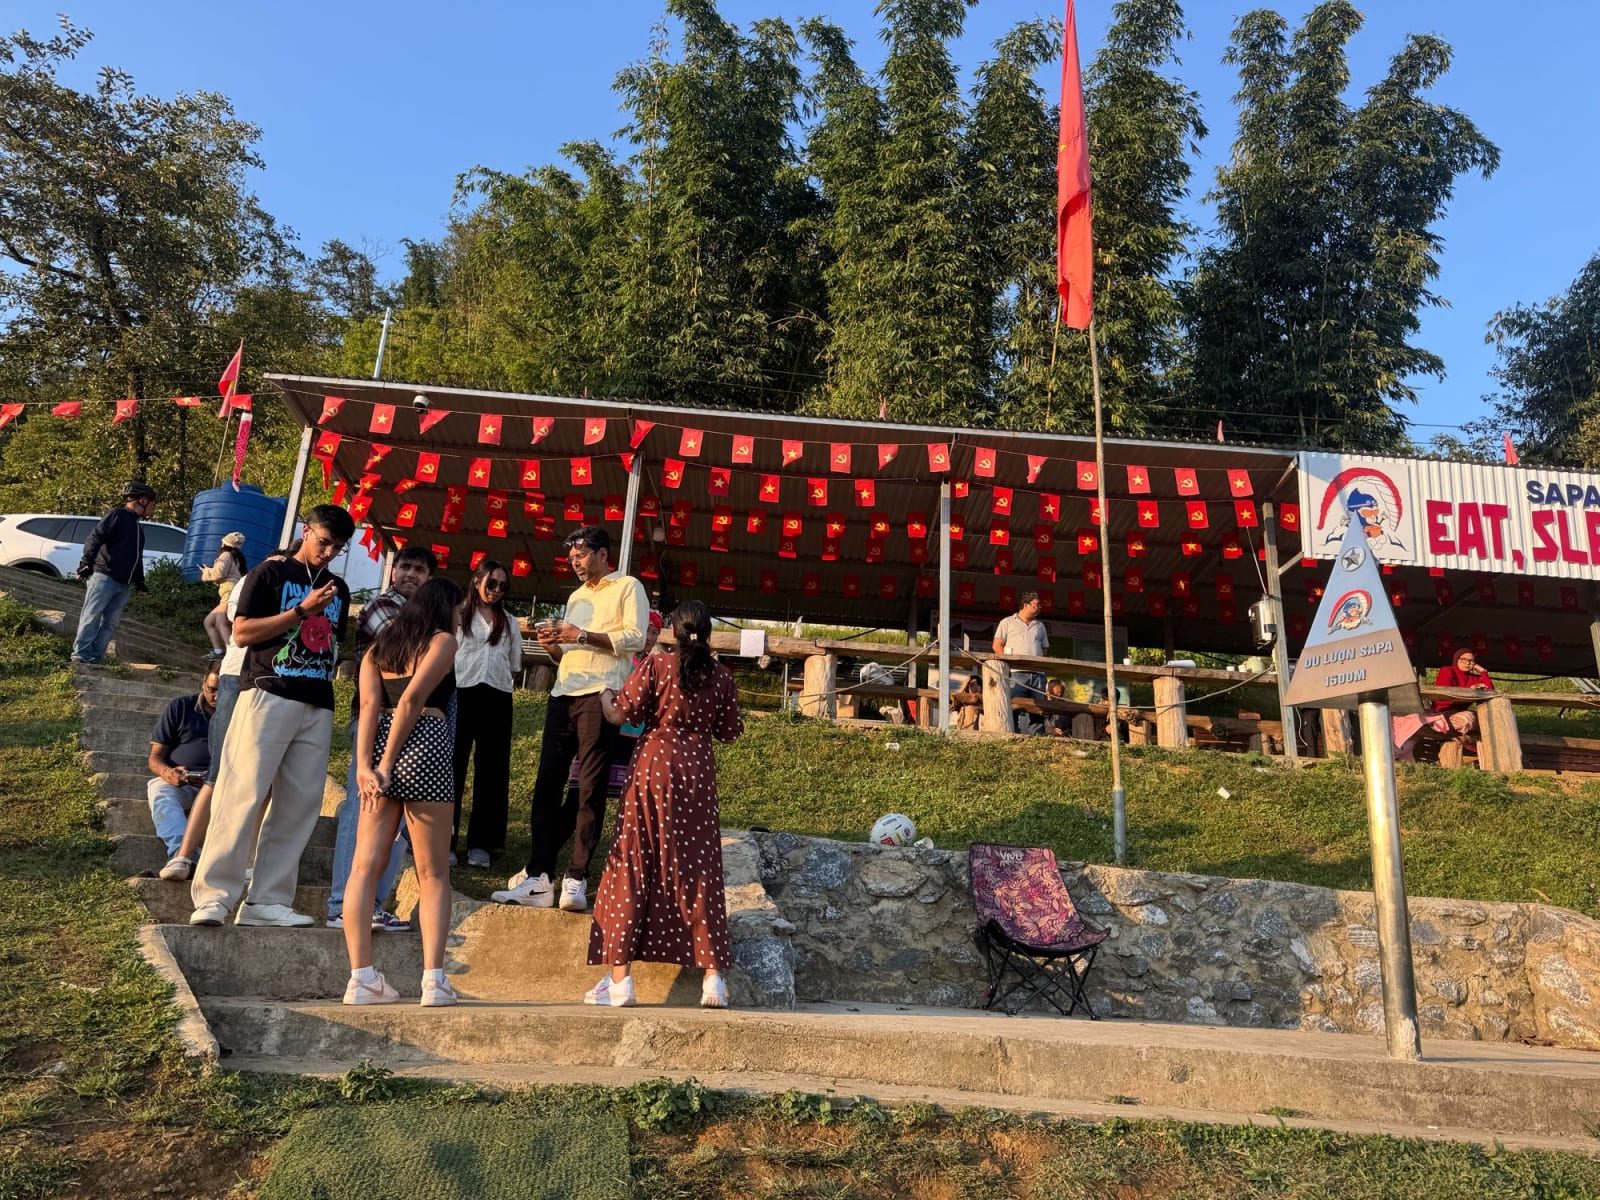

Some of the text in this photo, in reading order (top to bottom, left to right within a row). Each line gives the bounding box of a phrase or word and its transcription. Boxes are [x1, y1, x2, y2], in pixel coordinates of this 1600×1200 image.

[1526, 480, 1600, 508] SAPA
[1426, 499, 1524, 571] EAT,
[1304, 656, 1320, 669] DU
[1360, 640, 1393, 657] SAPA
[1324, 669, 1366, 687] 1500M
